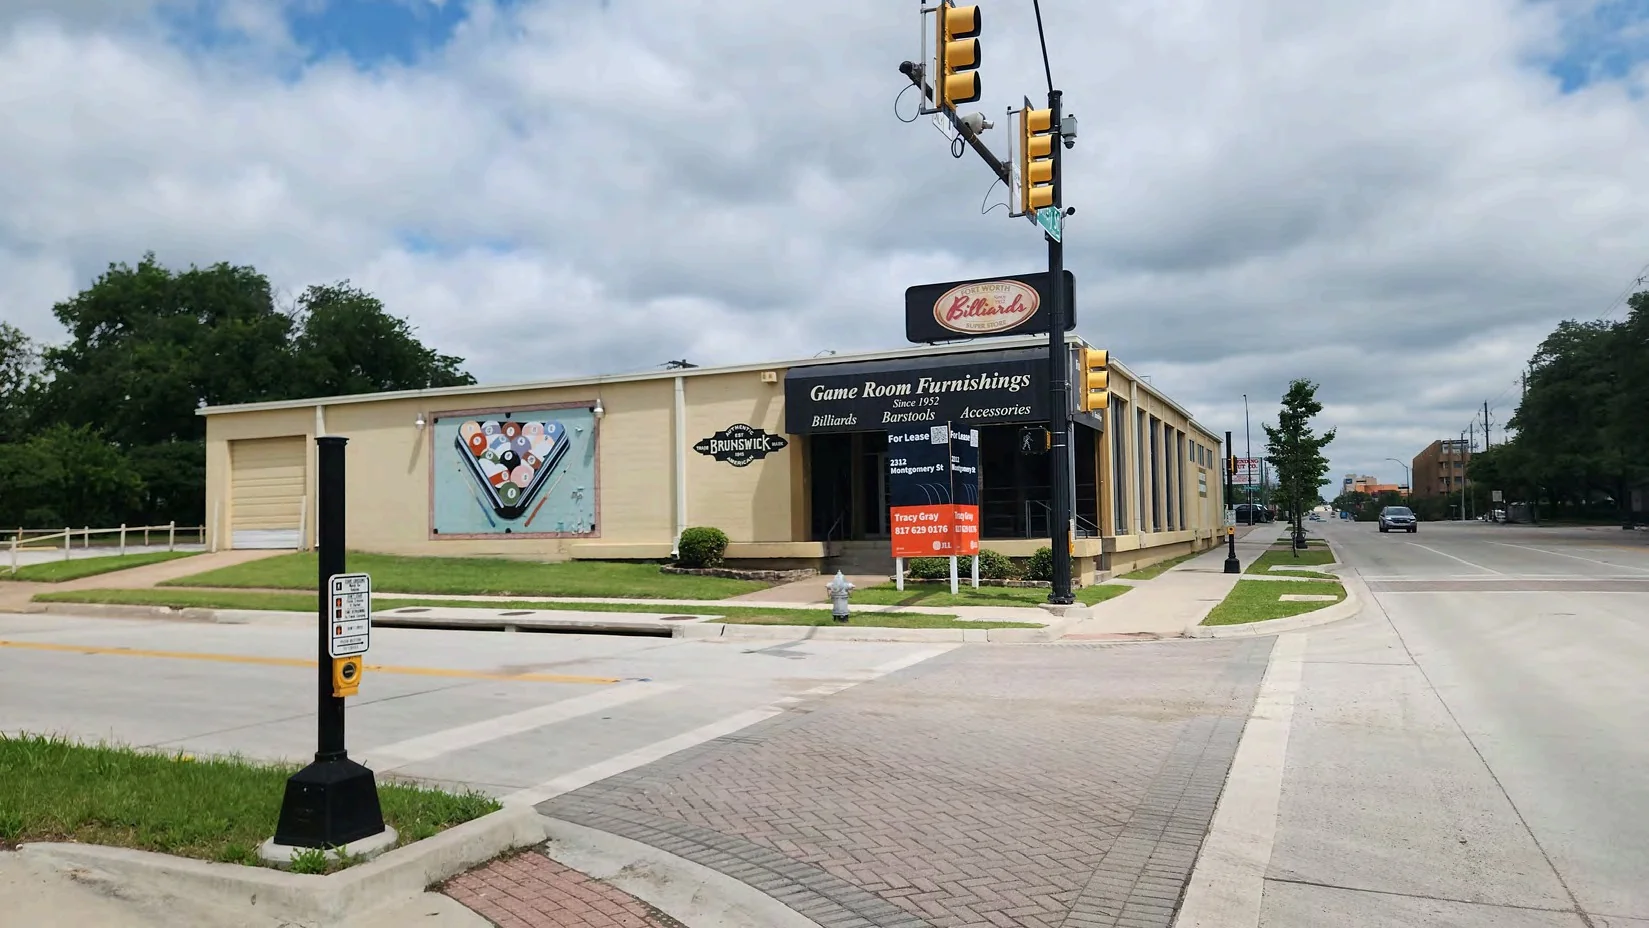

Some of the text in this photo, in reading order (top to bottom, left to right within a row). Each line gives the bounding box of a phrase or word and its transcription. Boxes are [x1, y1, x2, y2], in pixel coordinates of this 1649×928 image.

[961, 286, 981, 296] FORT
[946, 294, 1026, 322] Billiards
[810, 372, 1030, 402] Game Room Furnishings
[893, 396, 940, 408] Since 1952
[812, 404, 1031, 427] Billiards Barstools Accessories
[725, 424, 754, 437] AUTHENTIC
[888, 433, 930, 443] For Lease
[958, 431, 970, 441] Lease
[710, 434, 771, 454] BRUNSWICK
[726, 455, 754, 466] AMERICAN
[890, 458, 907, 466] 2312
[890, 464, 944, 474] Montgomery St
[894, 512, 939, 522] Tracy Gray
[895, 526, 910, 534] 817
[911, 525, 926, 534] 629
[928, 525, 948, 533] 0176
